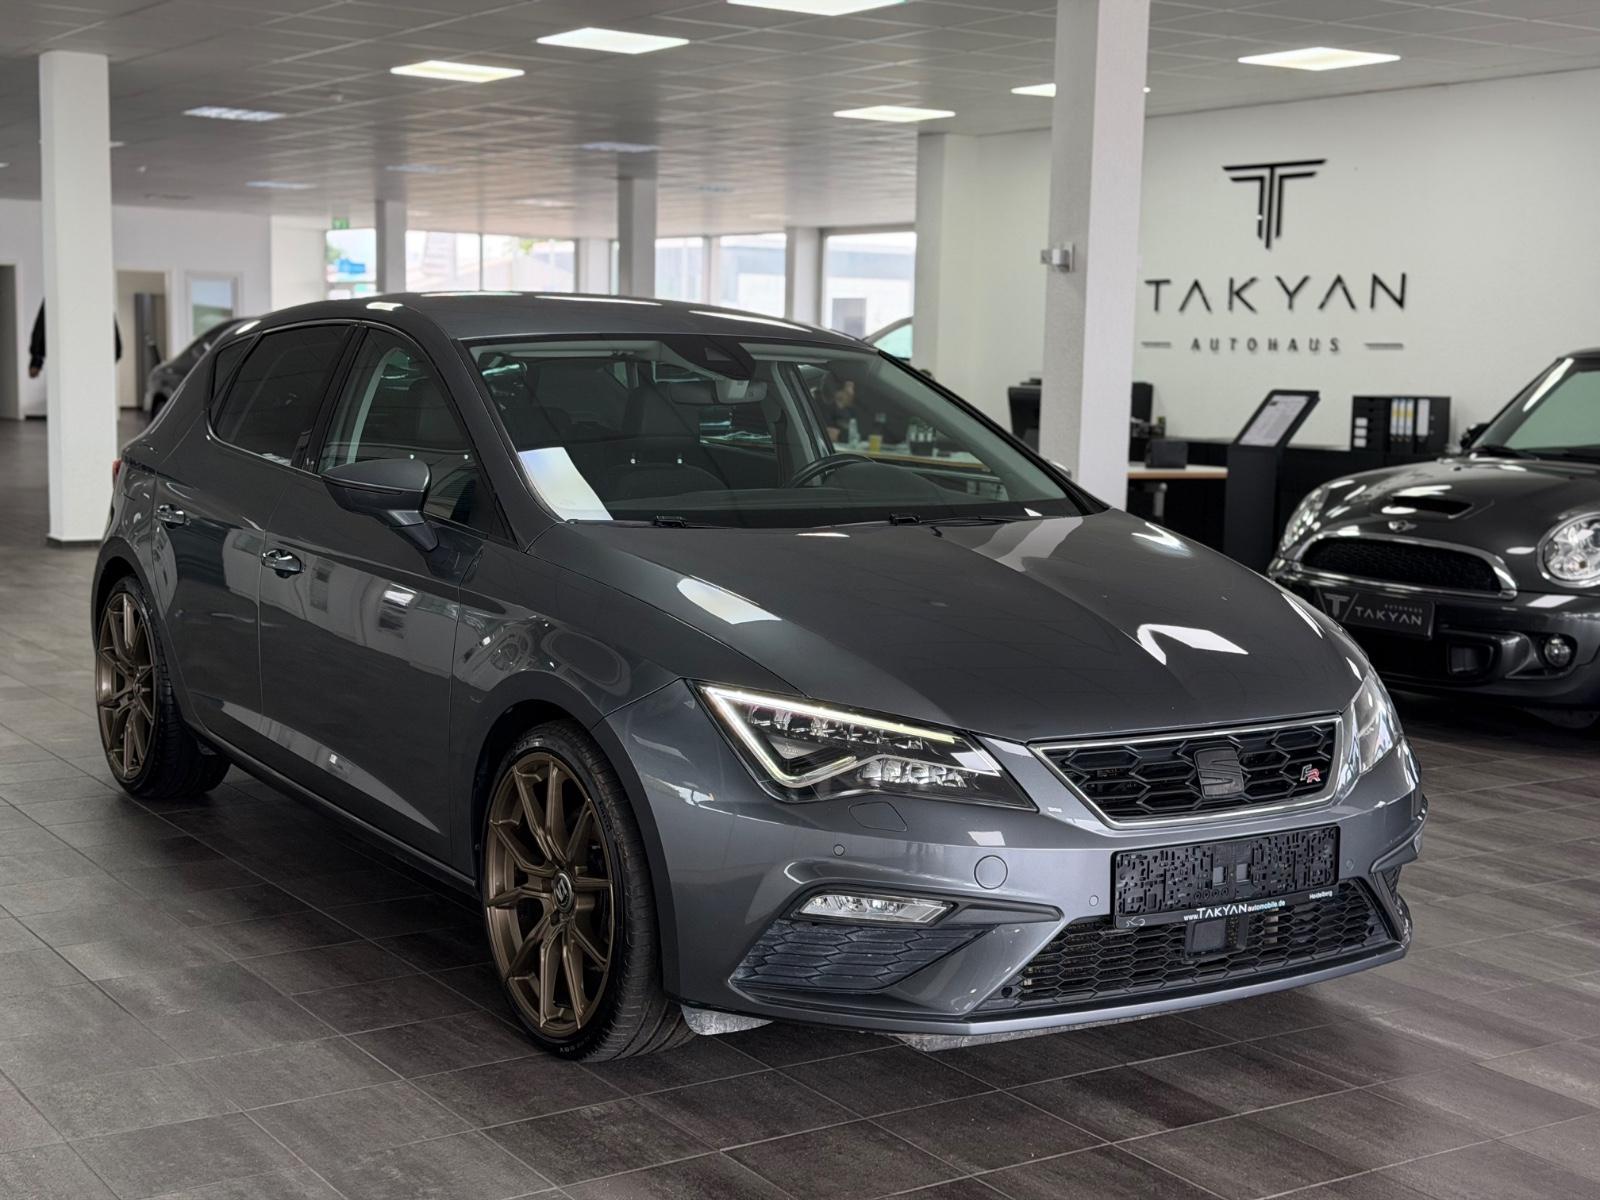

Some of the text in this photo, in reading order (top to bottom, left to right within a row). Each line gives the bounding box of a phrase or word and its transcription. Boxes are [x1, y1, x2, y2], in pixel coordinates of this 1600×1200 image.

[1144, 272, 1407, 313] TAKYAN
[1190, 337, 1342, 353] AUTOHAUS
[1355, 606, 1423, 626] TAKYAN
